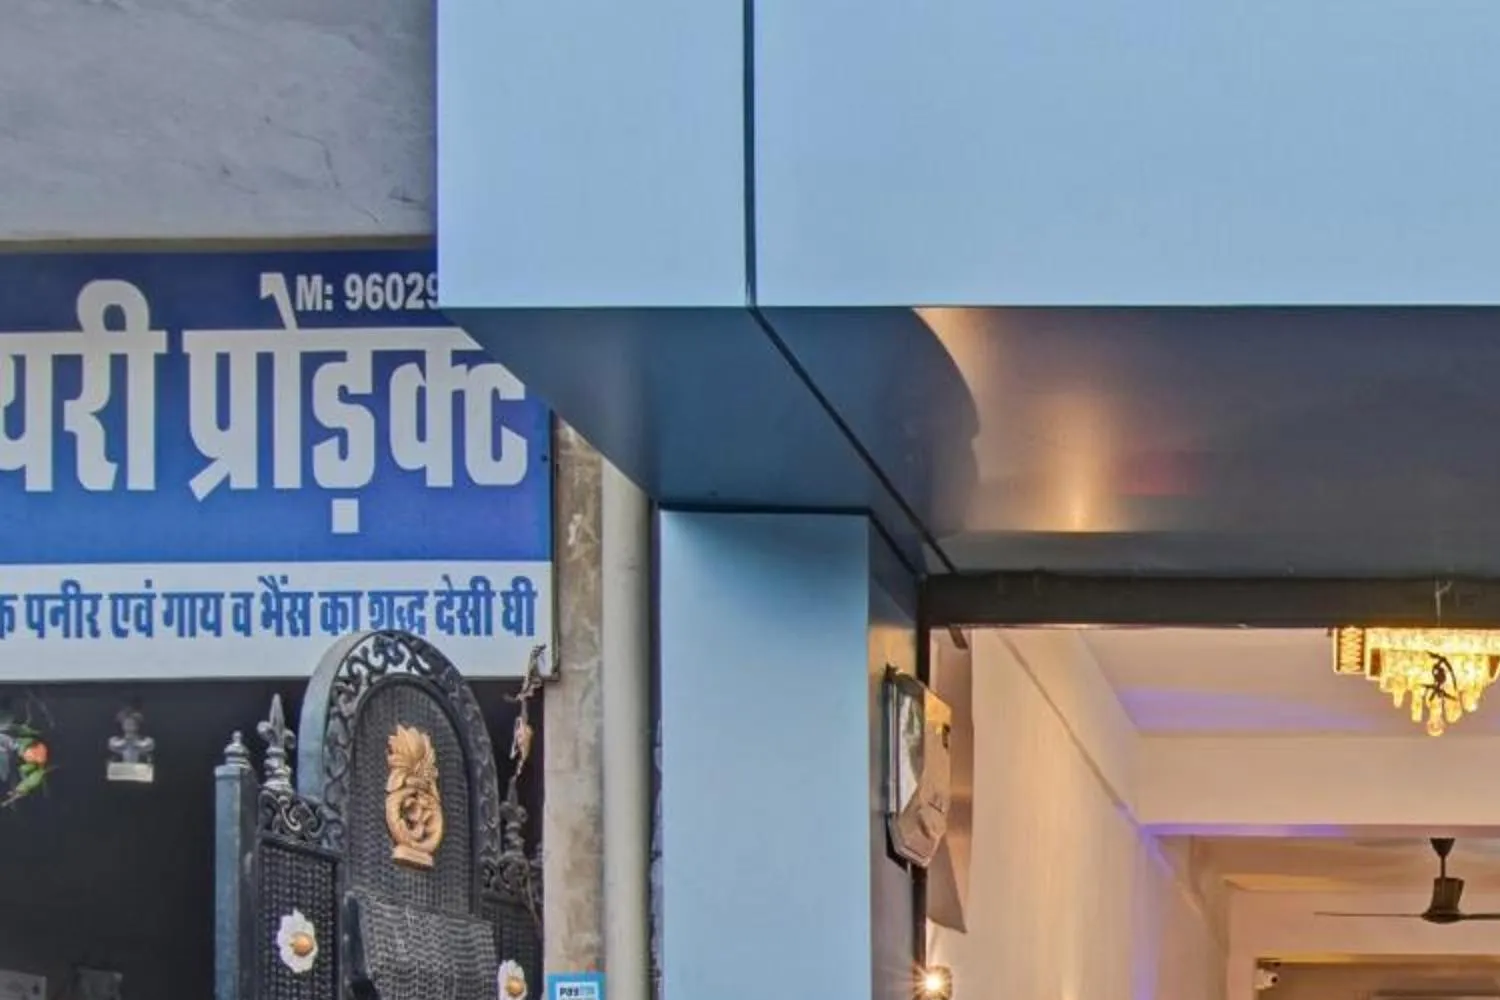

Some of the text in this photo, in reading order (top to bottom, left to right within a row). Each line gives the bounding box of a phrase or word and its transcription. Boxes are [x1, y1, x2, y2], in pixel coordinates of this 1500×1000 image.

[24, 579, 102, 638] पनीर
[109, 579, 156, 638] एवं
[161, 592, 225, 637] गाय
[230, 592, 254, 637] व
[257, 575, 314, 637] भैंस
[318, 591, 363, 636] का
[434, 574, 496, 636] देसी
[500, 576, 538, 636] घी
